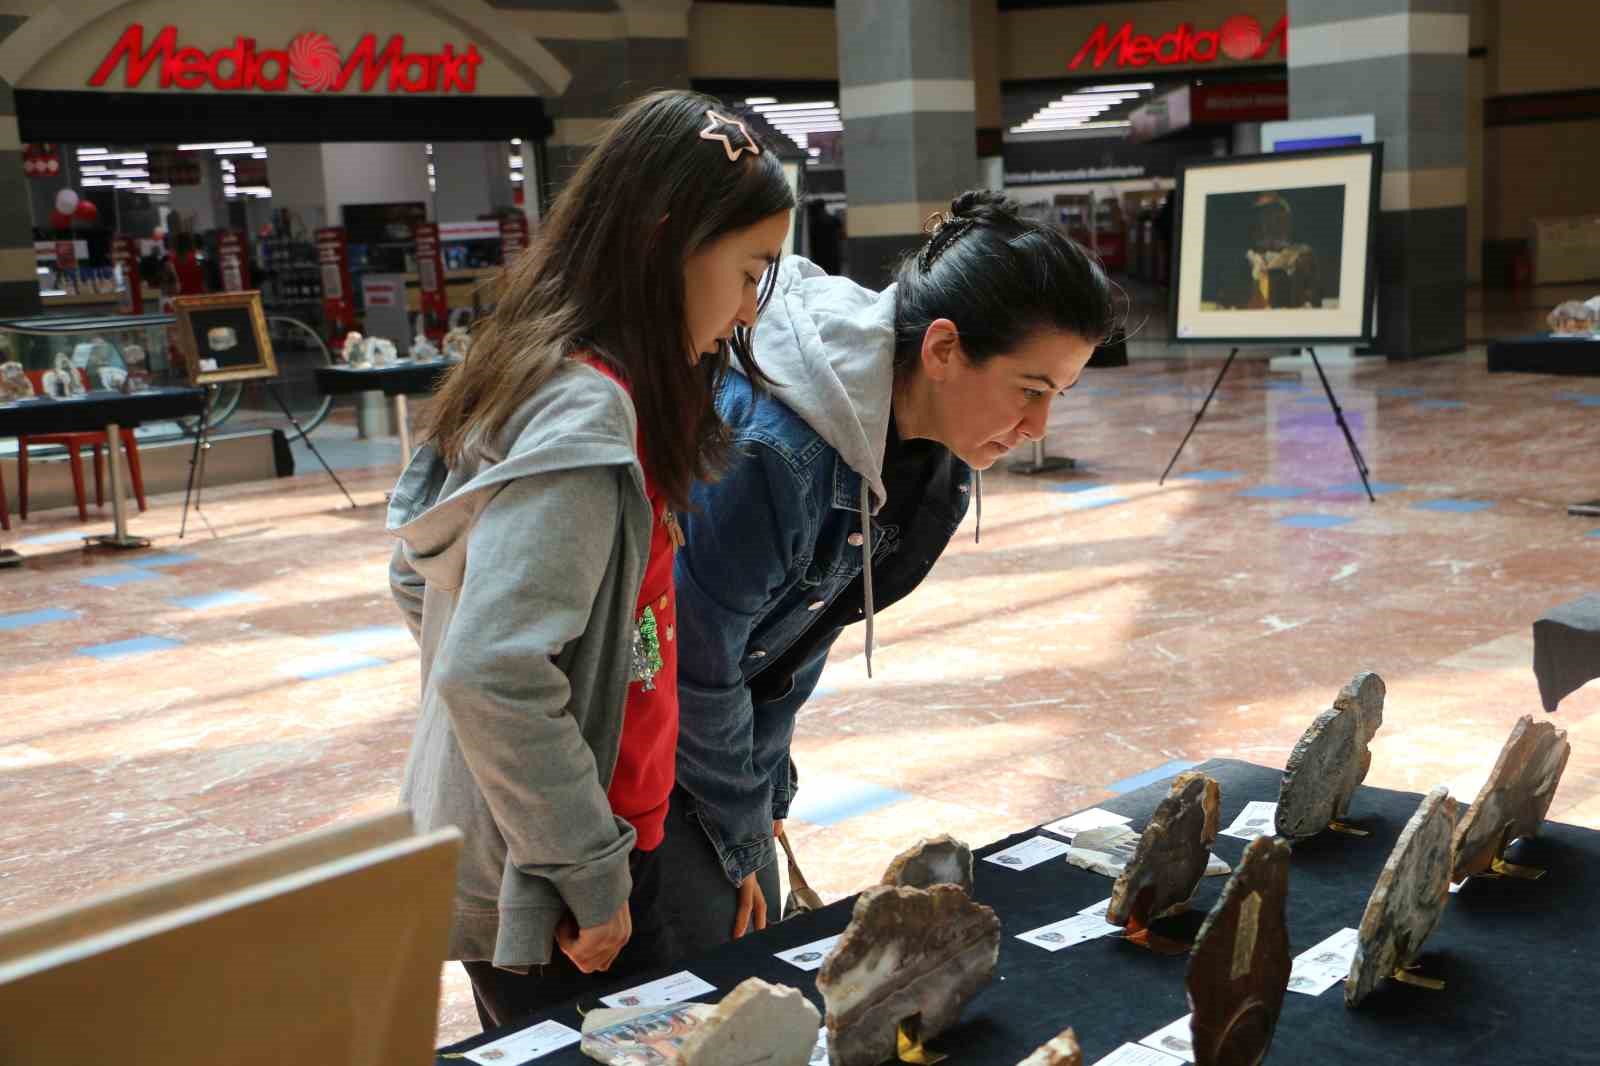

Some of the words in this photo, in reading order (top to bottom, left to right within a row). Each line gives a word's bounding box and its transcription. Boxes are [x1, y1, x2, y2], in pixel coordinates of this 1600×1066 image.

[88, 23, 290, 91] Media
[333, 33, 483, 93] Markt
[1067, 20, 1220, 71] Media
